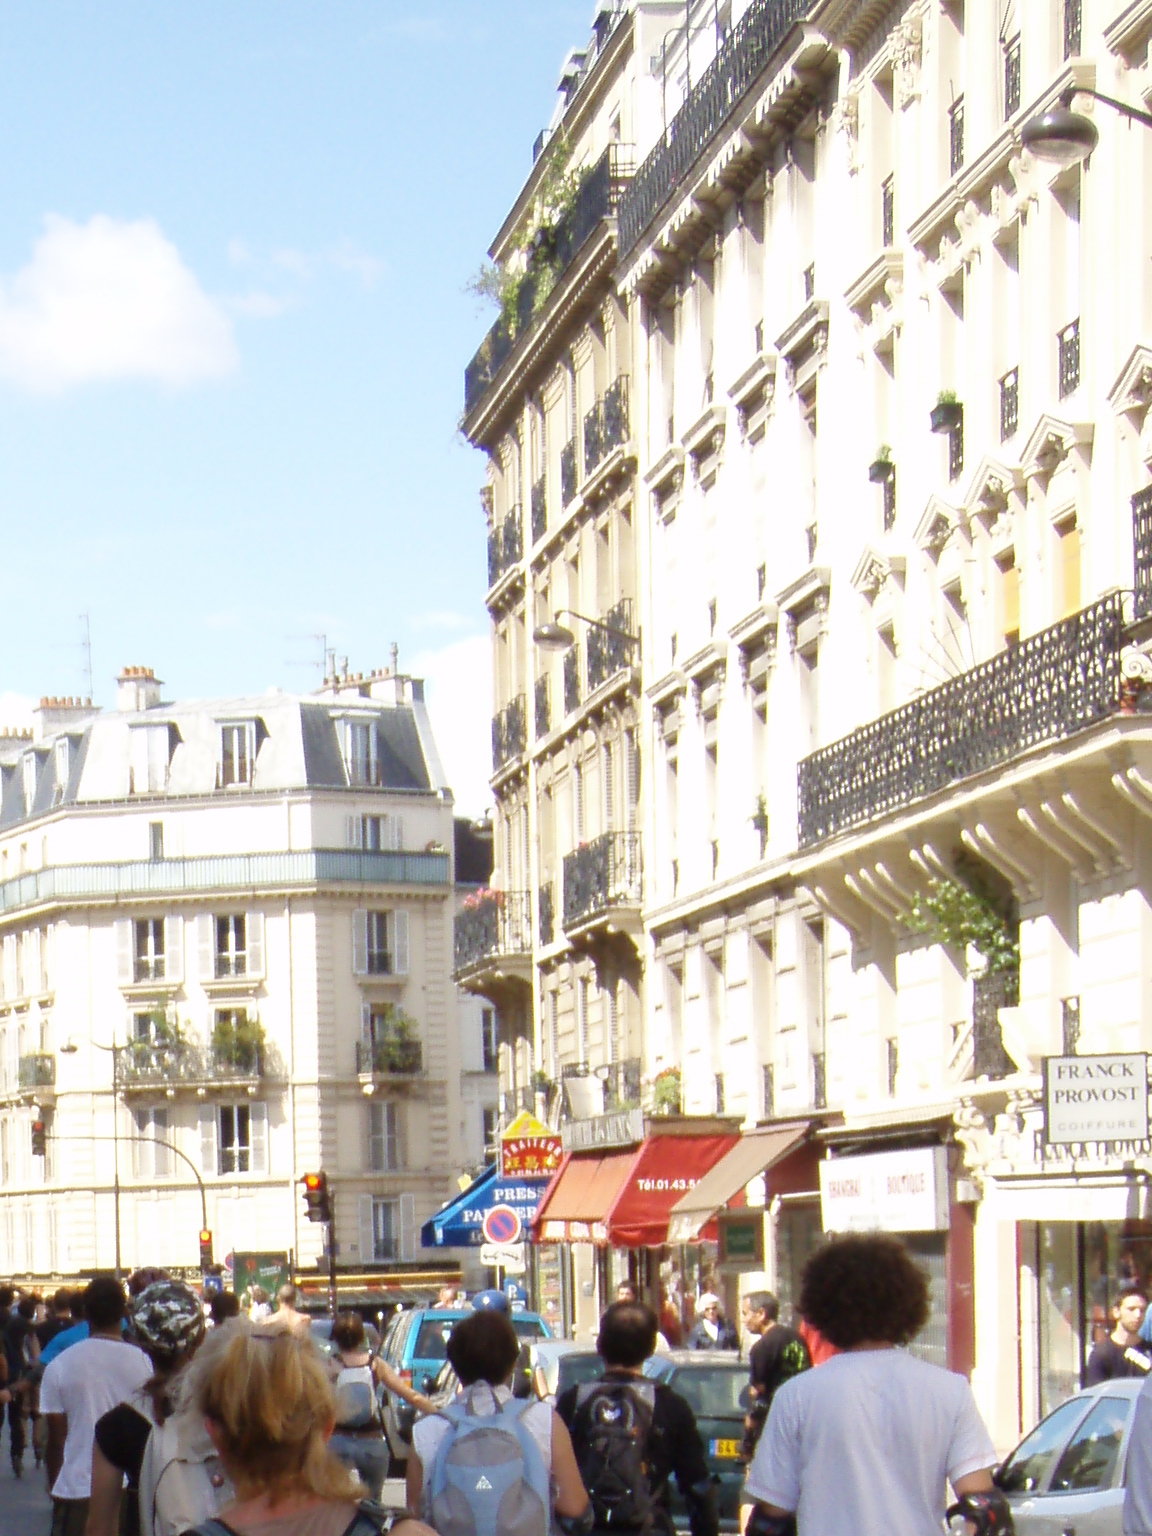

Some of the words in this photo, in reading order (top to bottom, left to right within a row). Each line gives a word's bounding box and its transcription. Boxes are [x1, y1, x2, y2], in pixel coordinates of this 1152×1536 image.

[1057, 1062, 1134, 1080] FRANCK
[1054, 1086, 1139, 1104] PROVOST
[1057, 1119, 1137, 1132] COIFFURE
[503, 1138, 562, 1158] TRAITEUR
[886, 1172, 926, 1196] BOUTIQUE
